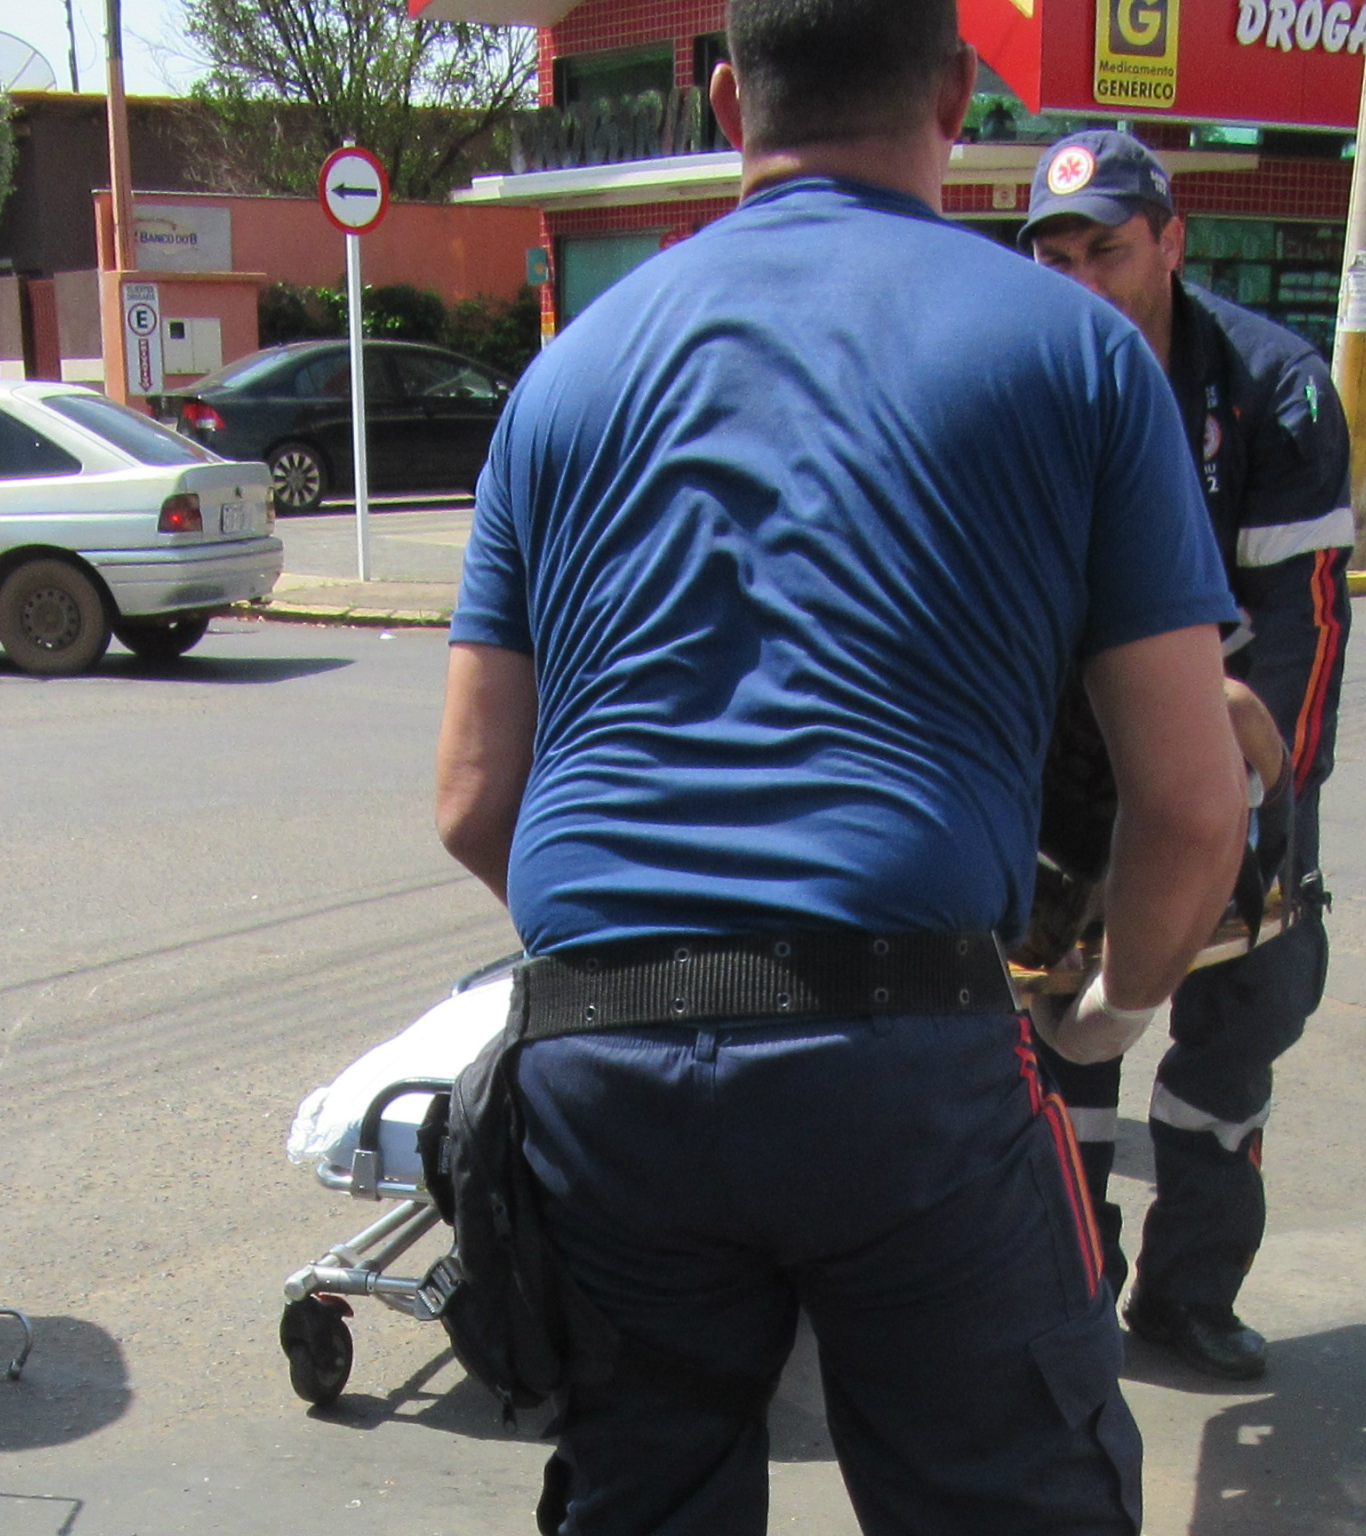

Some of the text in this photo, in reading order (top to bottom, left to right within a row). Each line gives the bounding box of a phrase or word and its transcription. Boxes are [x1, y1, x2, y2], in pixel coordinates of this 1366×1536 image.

[1117, 0, 1162, 46] G
[1099, 60, 1175, 77] Medicamento
[139, 231, 175, 245] BANCO
[136, 311, 148, 329] E
